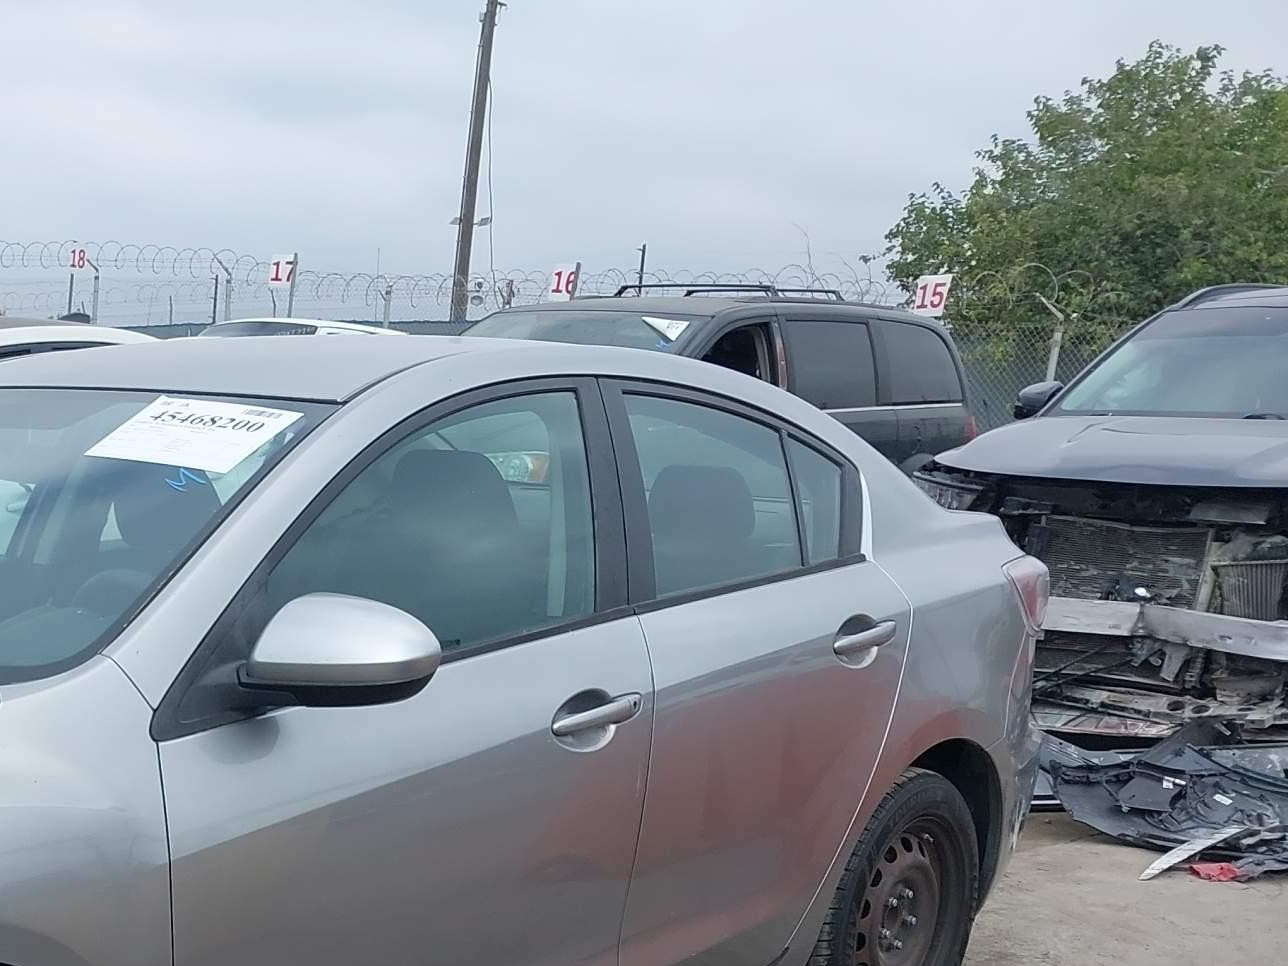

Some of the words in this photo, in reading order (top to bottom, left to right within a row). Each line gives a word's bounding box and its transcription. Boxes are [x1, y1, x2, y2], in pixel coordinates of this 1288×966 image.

[69, 248, 86, 269] 18
[270, 260, 296, 282] 17
[915, 282, 947, 309] 15
[149, 409, 265, 433] 45468200
